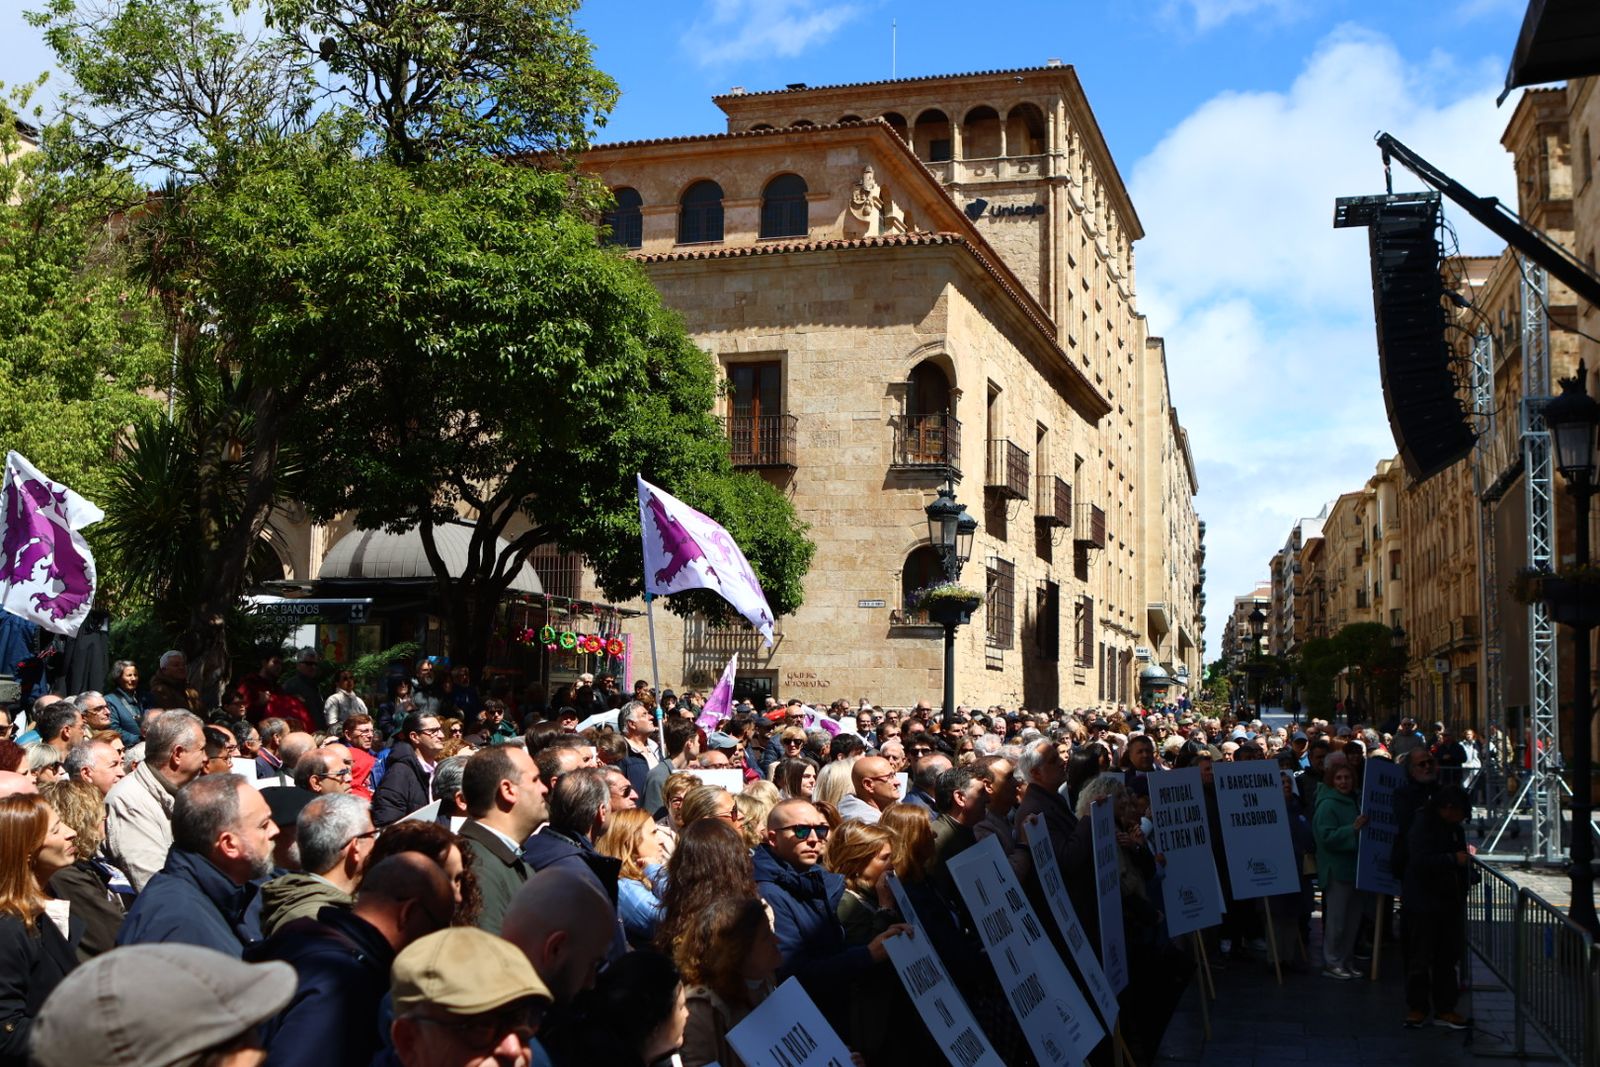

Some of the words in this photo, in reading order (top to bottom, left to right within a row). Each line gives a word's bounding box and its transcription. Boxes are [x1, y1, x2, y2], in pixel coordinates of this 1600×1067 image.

[991, 203, 1045, 218] Unicaja
[281, 604, 319, 614] BANDOS
[1219, 776, 1225, 791] A
[1227, 773, 1278, 790] BARCELONA,
[1159, 784, 1194, 805] PORTUGAL
[1242, 792, 1258, 808] SIN
[1155, 806, 1173, 828] ESTÁ
[1174, 808, 1183, 825] AL
[1184, 805, 1204, 824] LADO,
[1230, 809, 1278, 827] TRASBORDO
[1160, 830, 1170, 853] EL
[1170, 828, 1192, 850] TREN
[1194, 825, 1206, 847] NO
[1004, 887, 1028, 914] ADO,
[781, 1021, 818, 1065] RUTA
